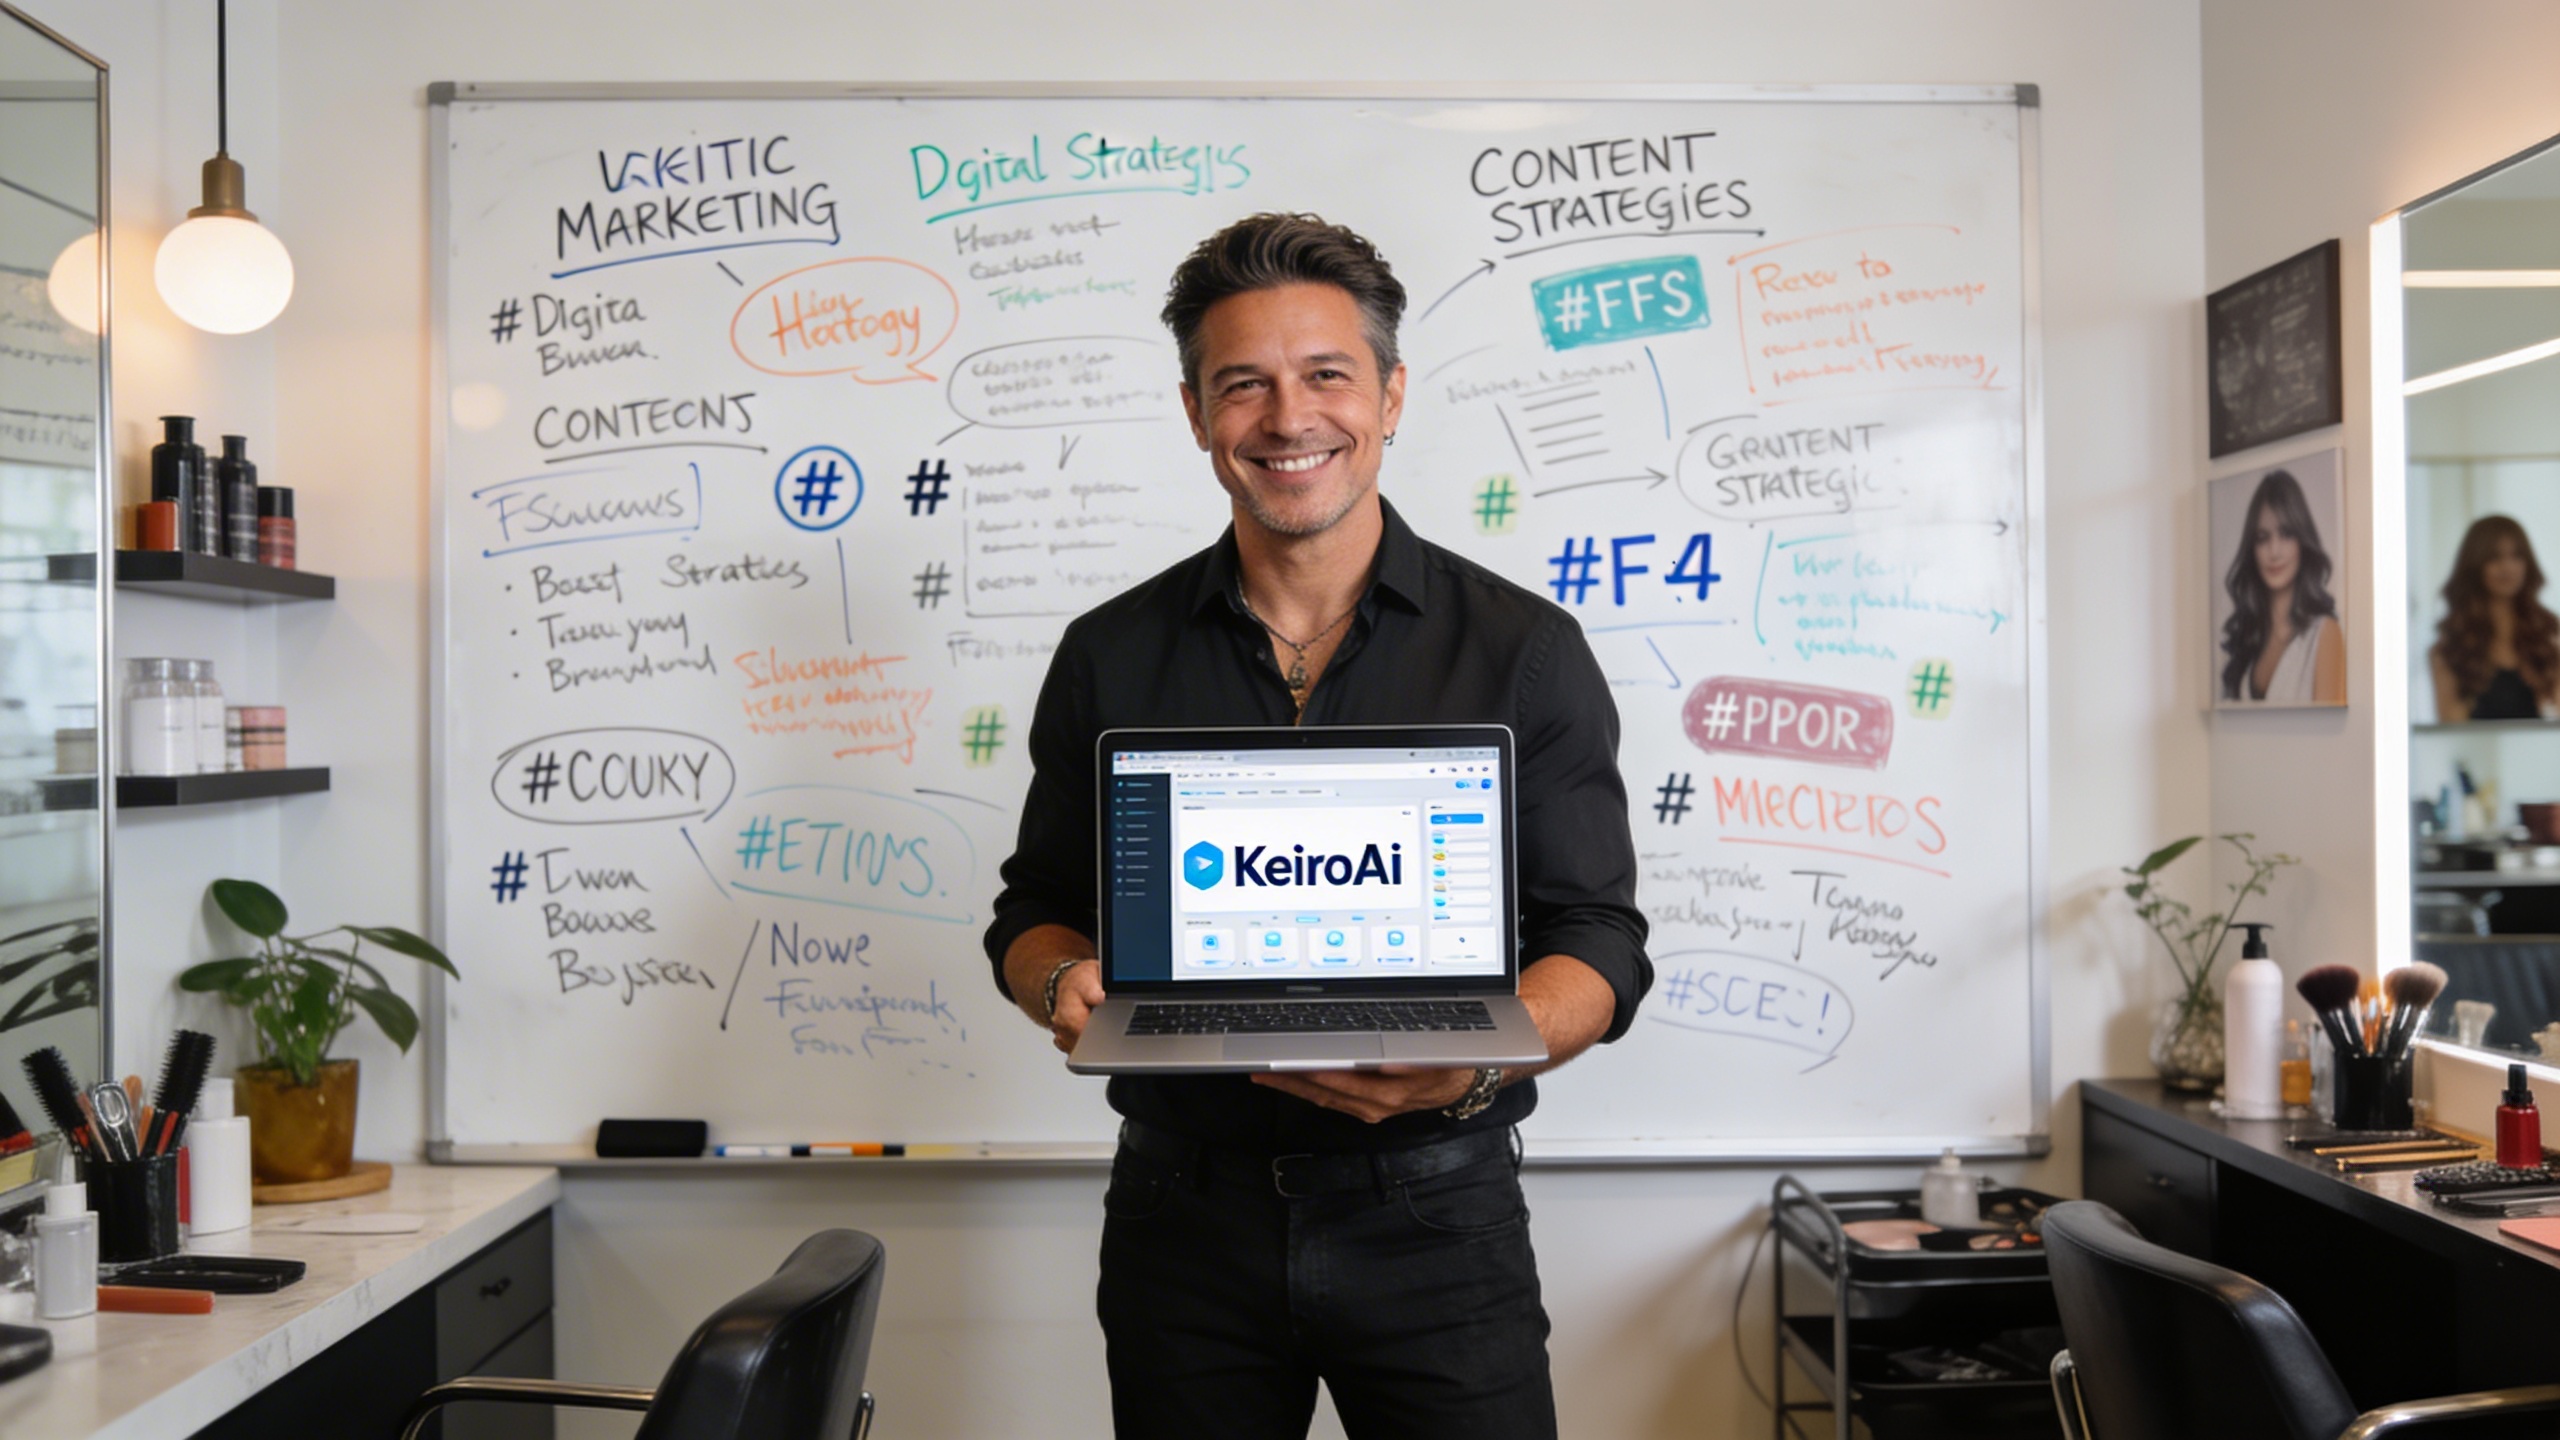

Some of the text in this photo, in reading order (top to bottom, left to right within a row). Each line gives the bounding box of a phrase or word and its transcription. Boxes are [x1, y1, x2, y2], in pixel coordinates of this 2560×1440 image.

[1471, 132, 1716, 197] CONTENT
[555, 182, 840, 260] MARKETING
[1555, 269, 1695, 334] #FFS
[1234, 842, 1402, 887] KeiroAi
